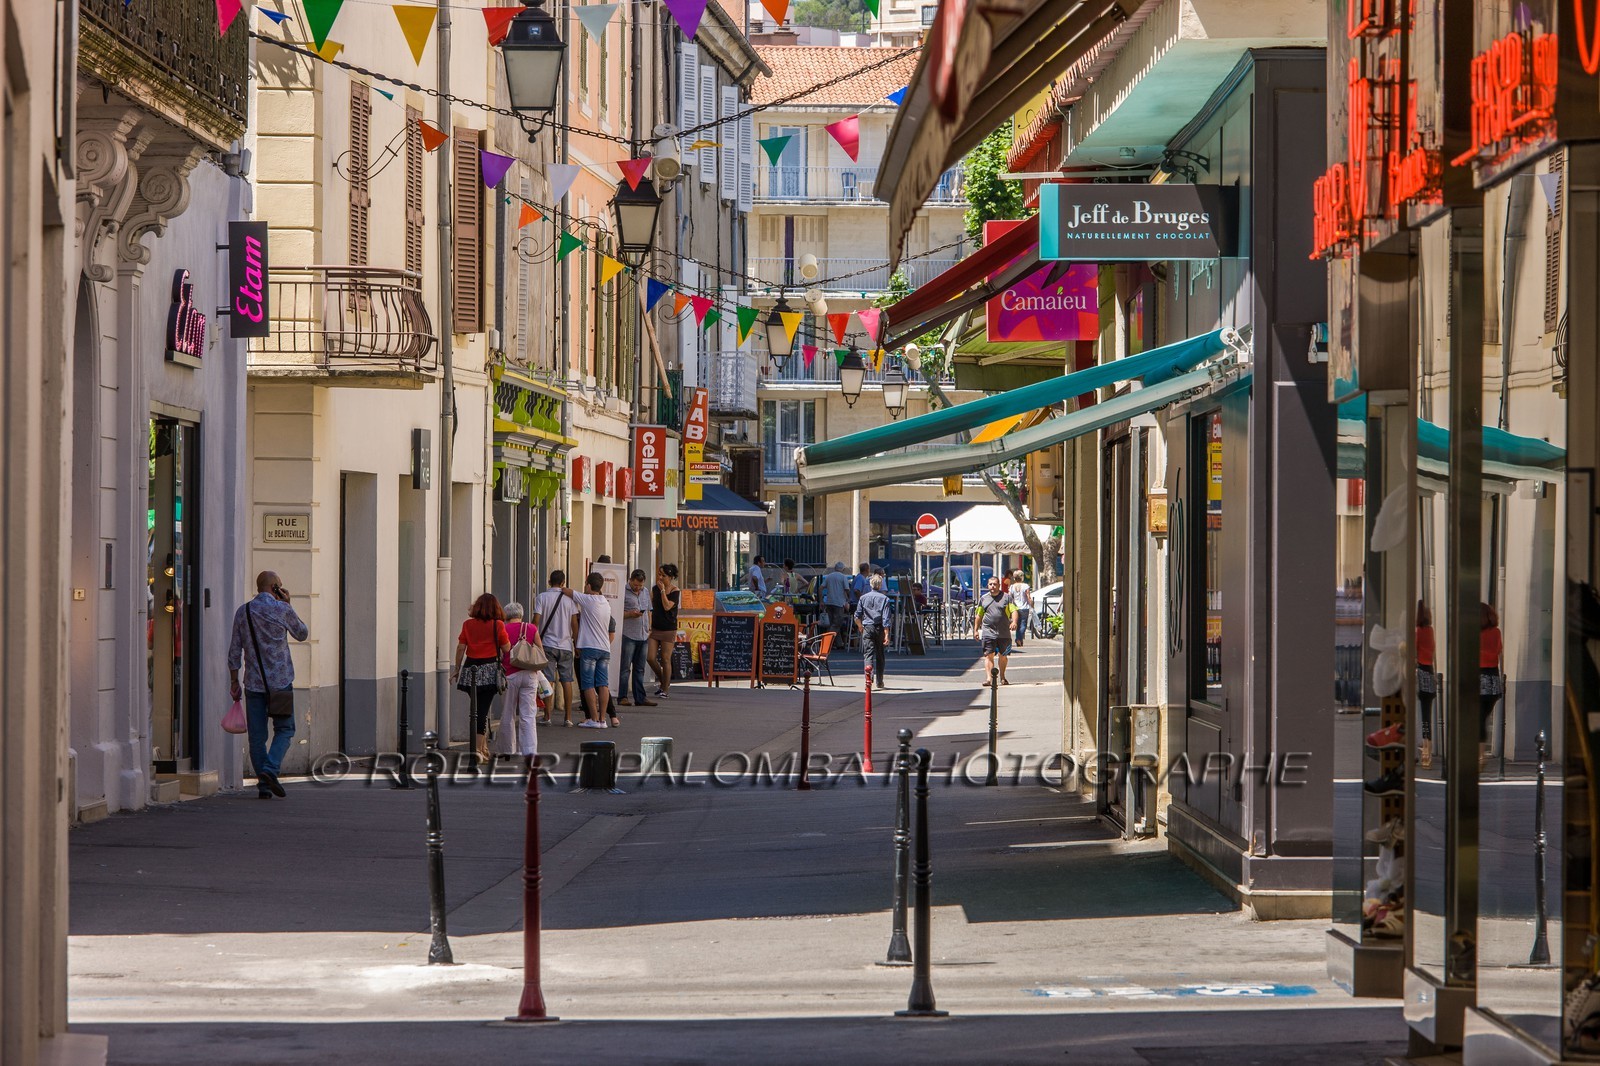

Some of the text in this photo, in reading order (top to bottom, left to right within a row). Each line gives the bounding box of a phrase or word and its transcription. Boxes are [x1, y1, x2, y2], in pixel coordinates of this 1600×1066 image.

[1067, 200, 1210, 230] Jeff de Bruges
[1067, 232, 1210, 240] NATURELLEMENT CHOCOLAT
[236, 235, 264, 323] Etam
[685, 390, 707, 441] TAB
[277, 518, 297, 527] RUE
[686, 515, 719, 529] COFFEE
[274, 529, 305, 538] BEAUTEVILLE
